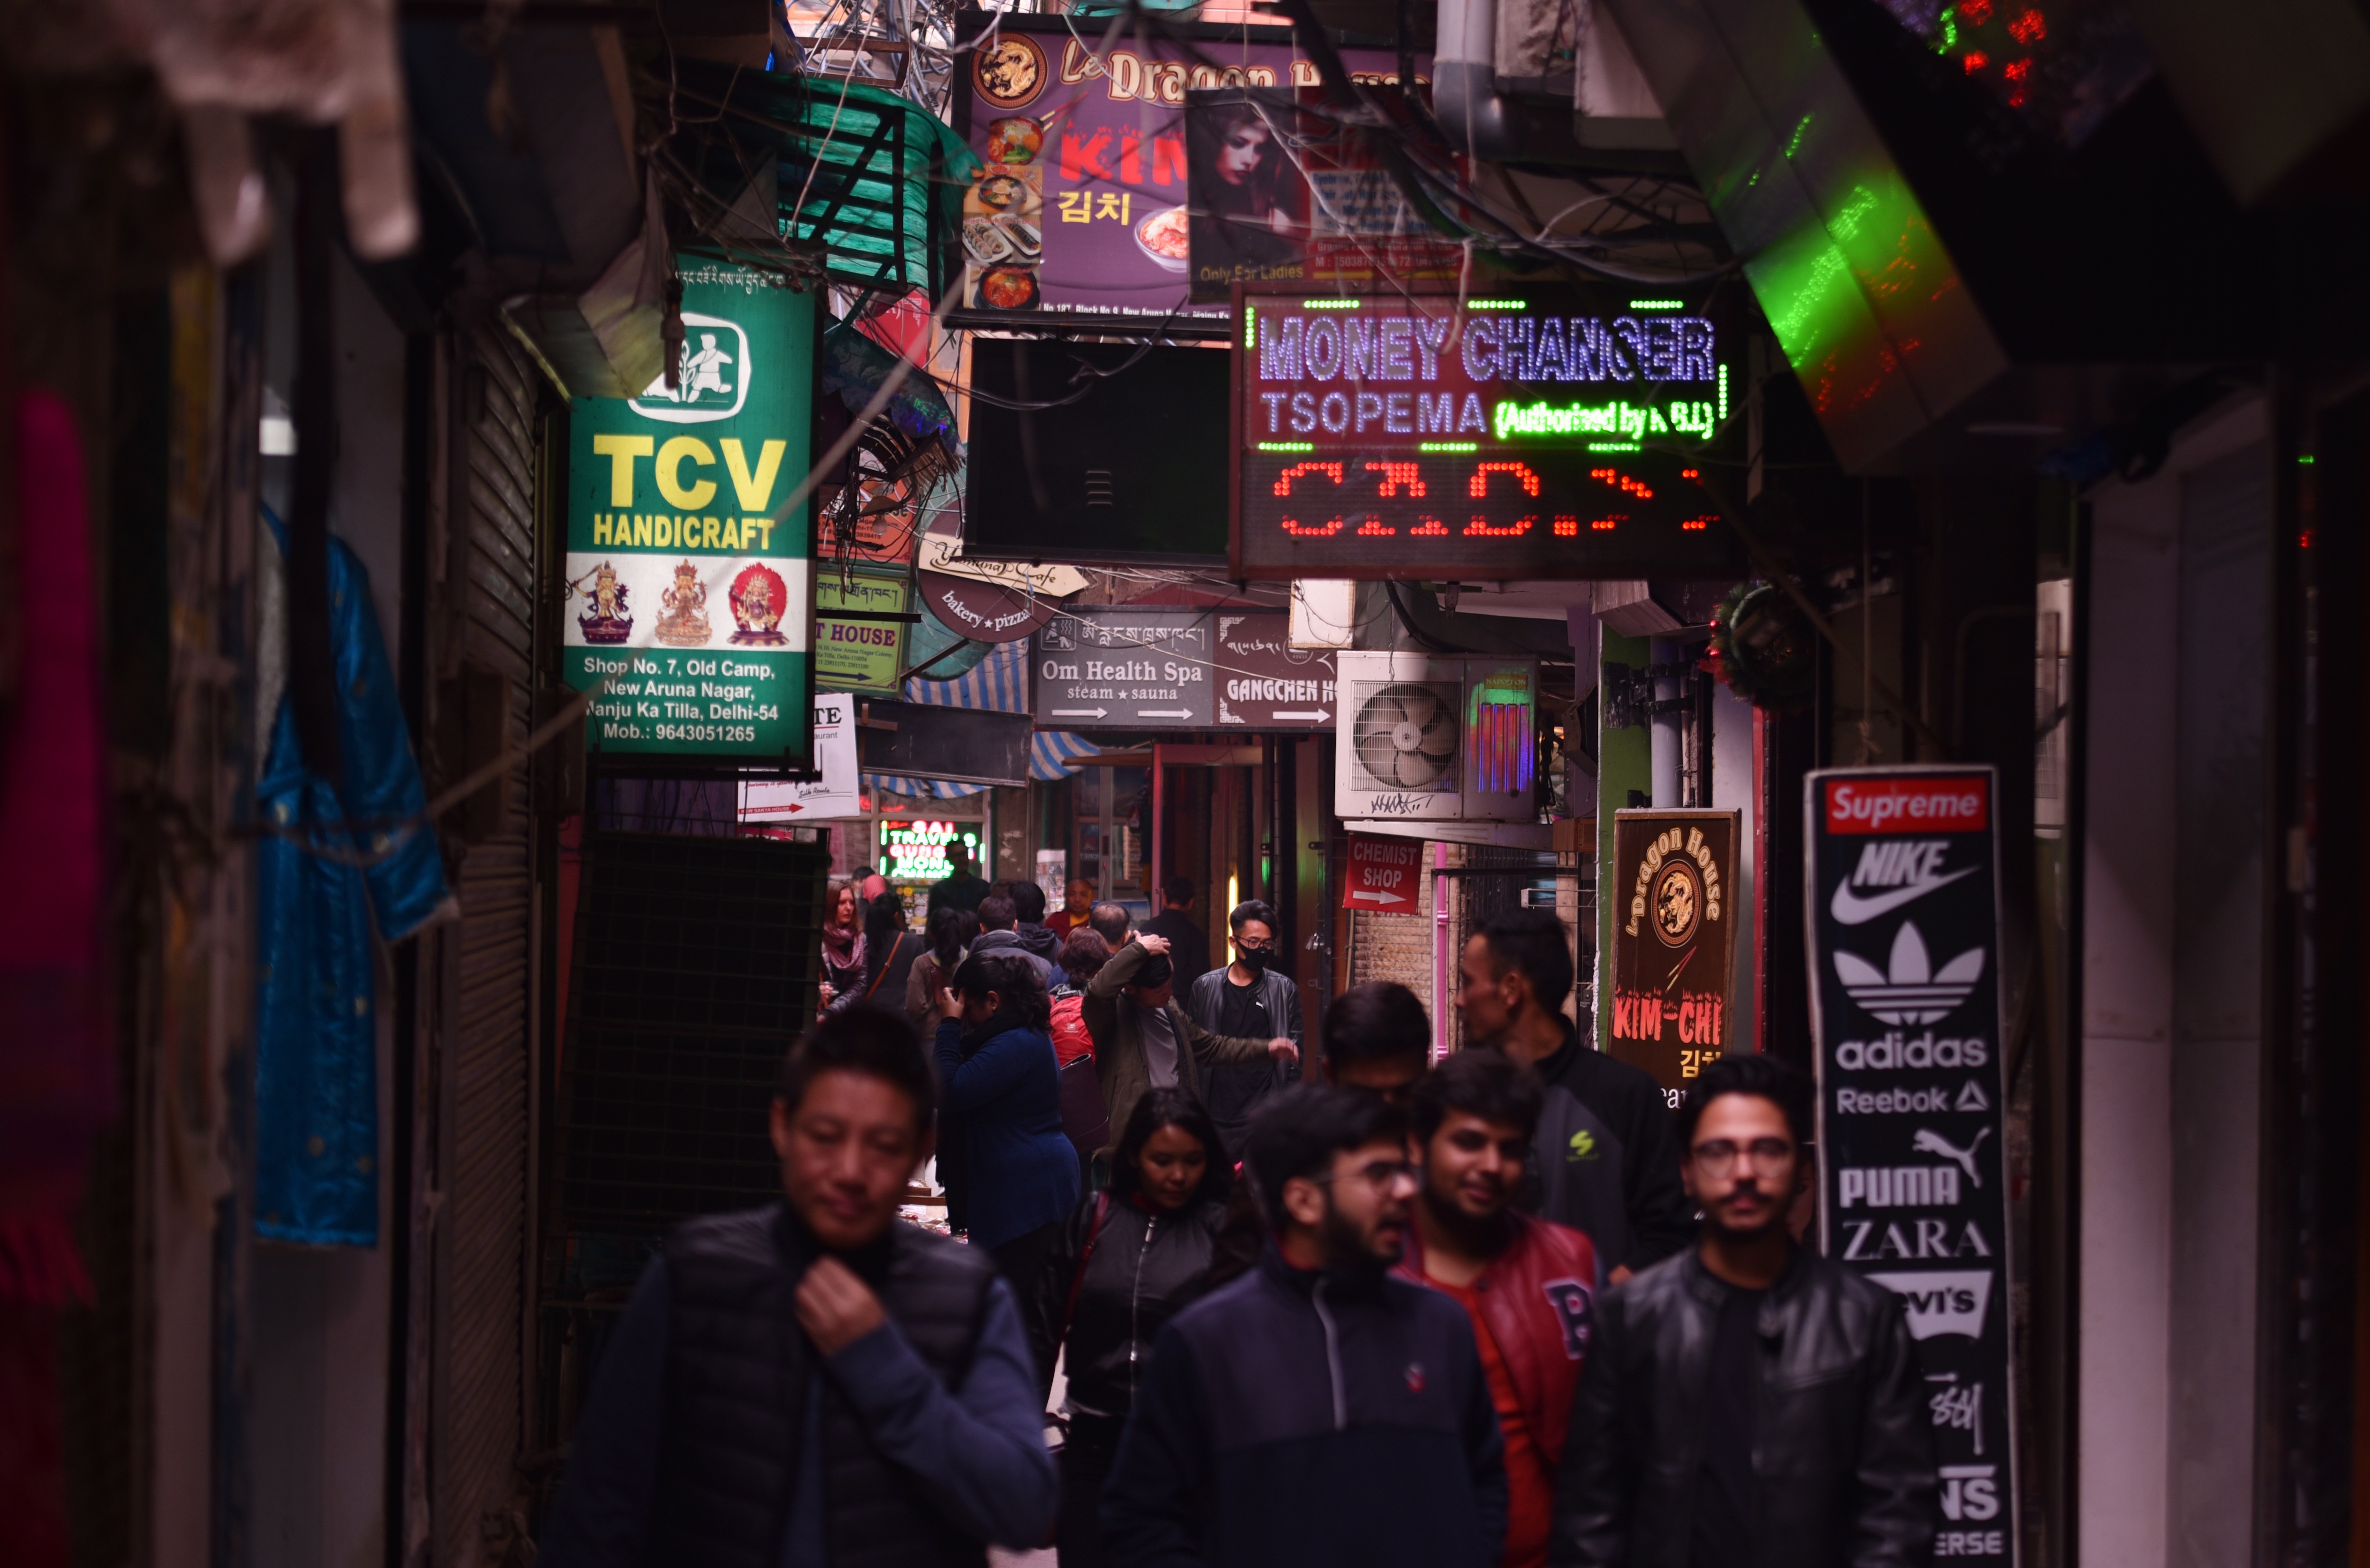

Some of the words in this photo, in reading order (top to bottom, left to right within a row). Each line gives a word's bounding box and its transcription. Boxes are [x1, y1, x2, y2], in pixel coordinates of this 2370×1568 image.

[1057, 191, 1130, 226] 김치
[1201, 267, 1231, 285] Only
[1261, 264, 1303, 279] Ladies
[1260, 317, 1450, 380] MONEY
[1461, 316, 1715, 381] CHANGER
[1261, 392, 1487, 434] TSOPEMA
[593, 434, 787, 511] TCV
[593, 514, 775, 550] HANDICRAFT
[941, 590, 984, 628] bakery
[994, 609, 1032, 631] pizza
[830, 623, 895, 647] HOUSE
[584, 657, 628, 676] Shop
[633, 659, 661, 675] No.
[666, 659, 682, 677] 7,
[686, 660, 716, 676] Old
[721, 661, 775, 681] Camp,
[1042, 660, 1079, 680] Om
[1086, 660, 1157, 681] Health
[1164, 662, 1203, 687] Spa
[604, 680, 640, 695] New
[644, 681, 696, 697] Aruna
[701, 682, 755, 702] Nagar,
[1067, 686, 1113, 700] steam
[1131, 689, 1178, 700] sauna
[1227, 679, 1318, 704] GANGCHEN
[637, 702, 659, 718] Ka
[664, 702, 704, 721] Tilla,
[710, 704, 779, 721] Delhi-54
[604, 723, 650, 739] Mob.:
[656, 725, 755, 742] 9643051265
[814, 732, 838, 740] aurant
[1832, 787, 1979, 827] Supreme
[1354, 842, 1417, 866] CHEMIST
[1852, 841, 1950, 886] NIKE
[1363, 867, 1402, 888] SHOP
[1632, 827, 1682, 917] Dragon
[1686, 826, 1721, 921] House
[1613, 987, 1723, 1046] KIM-CHI
[1835, 1031, 1987, 1070] adidas
[1836, 1087, 1949, 1115] Reebok
[1839, 1166, 1960, 1208] PUMA
[1842, 1220, 1992, 1260] ZARA
[1934, 1531, 2004, 1556] ERSE
